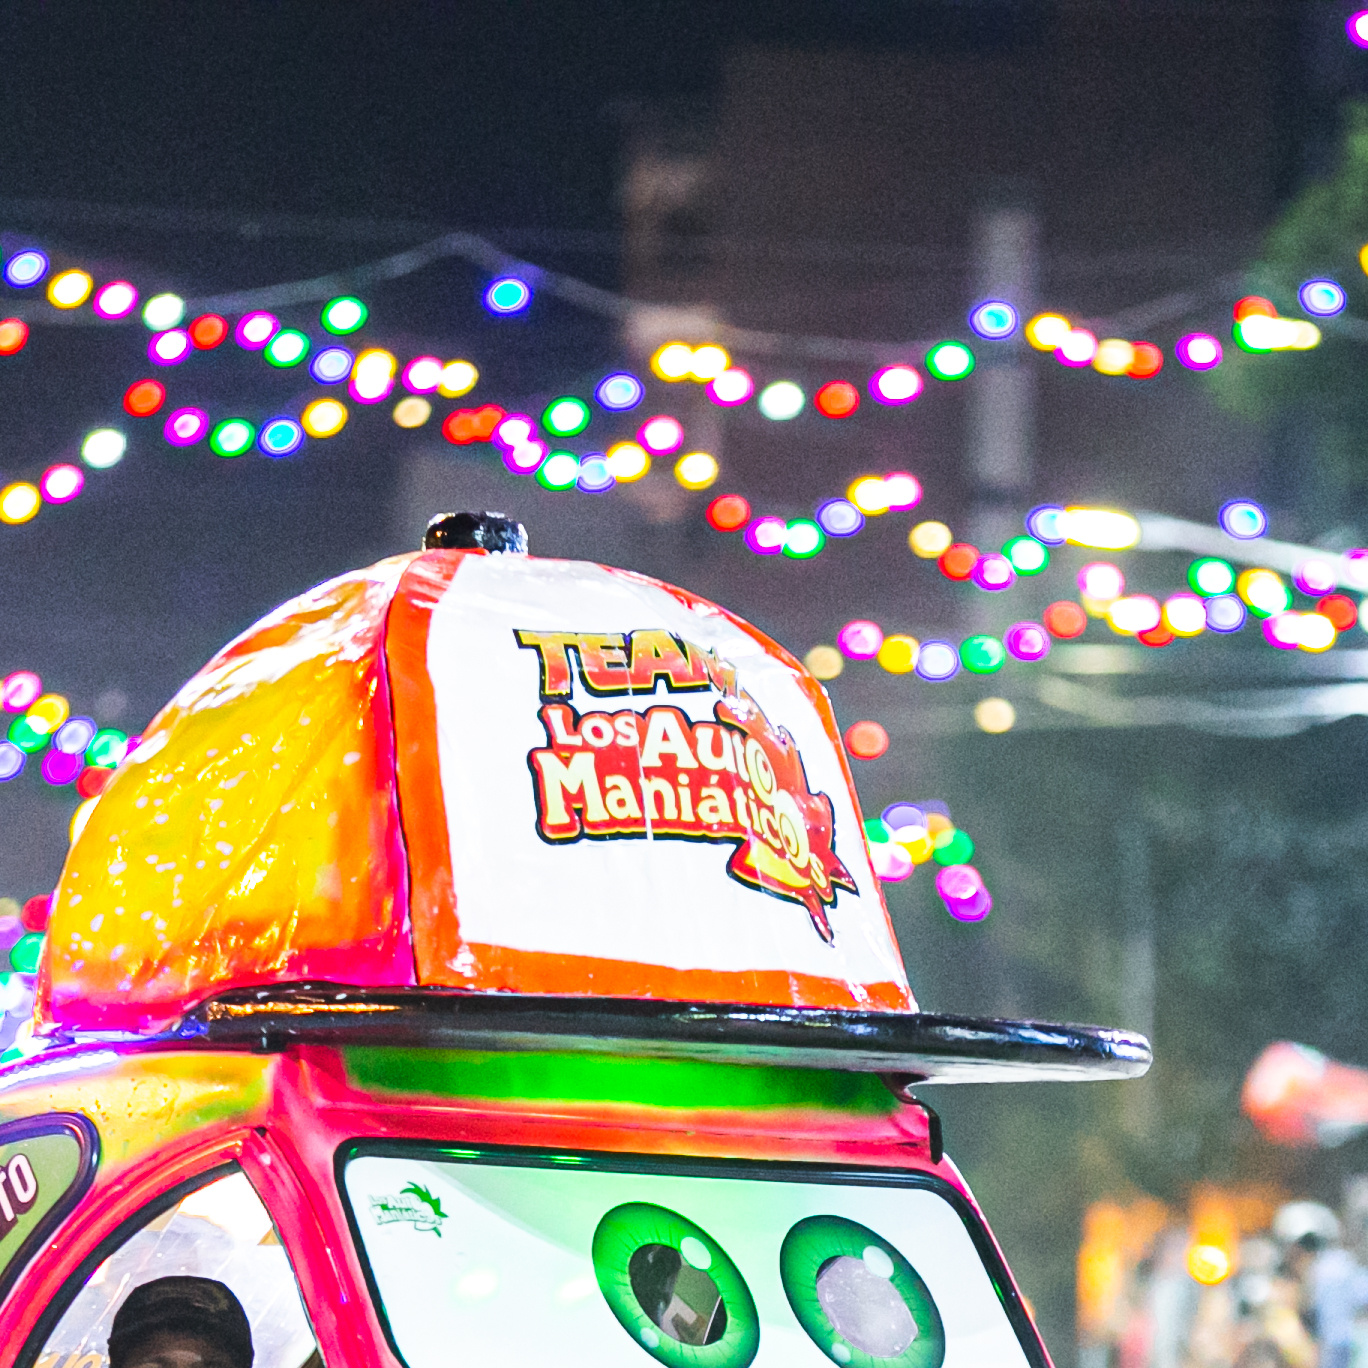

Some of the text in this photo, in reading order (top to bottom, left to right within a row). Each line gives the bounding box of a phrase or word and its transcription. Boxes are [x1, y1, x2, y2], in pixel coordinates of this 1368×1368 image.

[513, 629, 739, 701] TEAM
[546, 707, 775, 799] Los Auto
